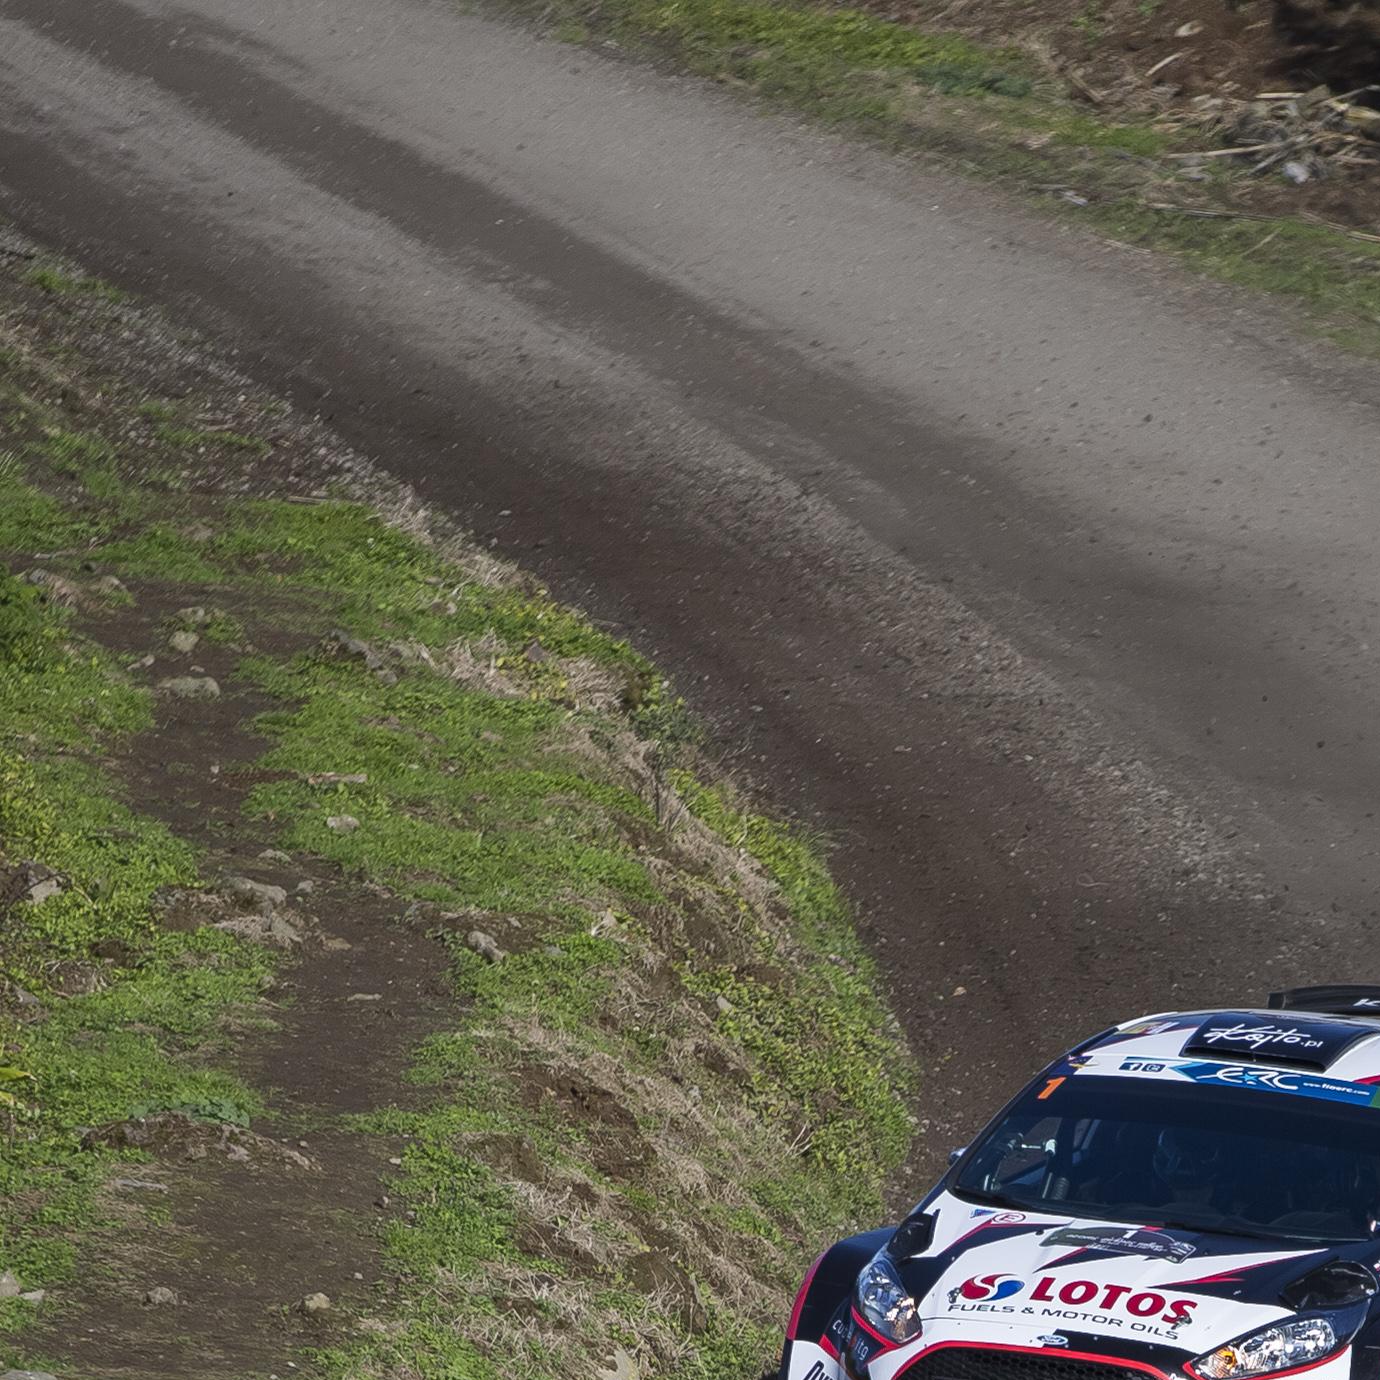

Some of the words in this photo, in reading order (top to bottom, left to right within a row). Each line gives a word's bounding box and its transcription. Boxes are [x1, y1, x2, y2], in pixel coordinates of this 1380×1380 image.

[1037, 1077, 1066, 1100] 1
[1029, 1277, 1198, 1324] LOTOS
[948, 1304, 1015, 1314] FUELS
[1021, 1306, 1035, 1315] &
[1041, 1308, 1123, 1328] MOTOR
[1131, 1321, 1178, 1340] OILS
